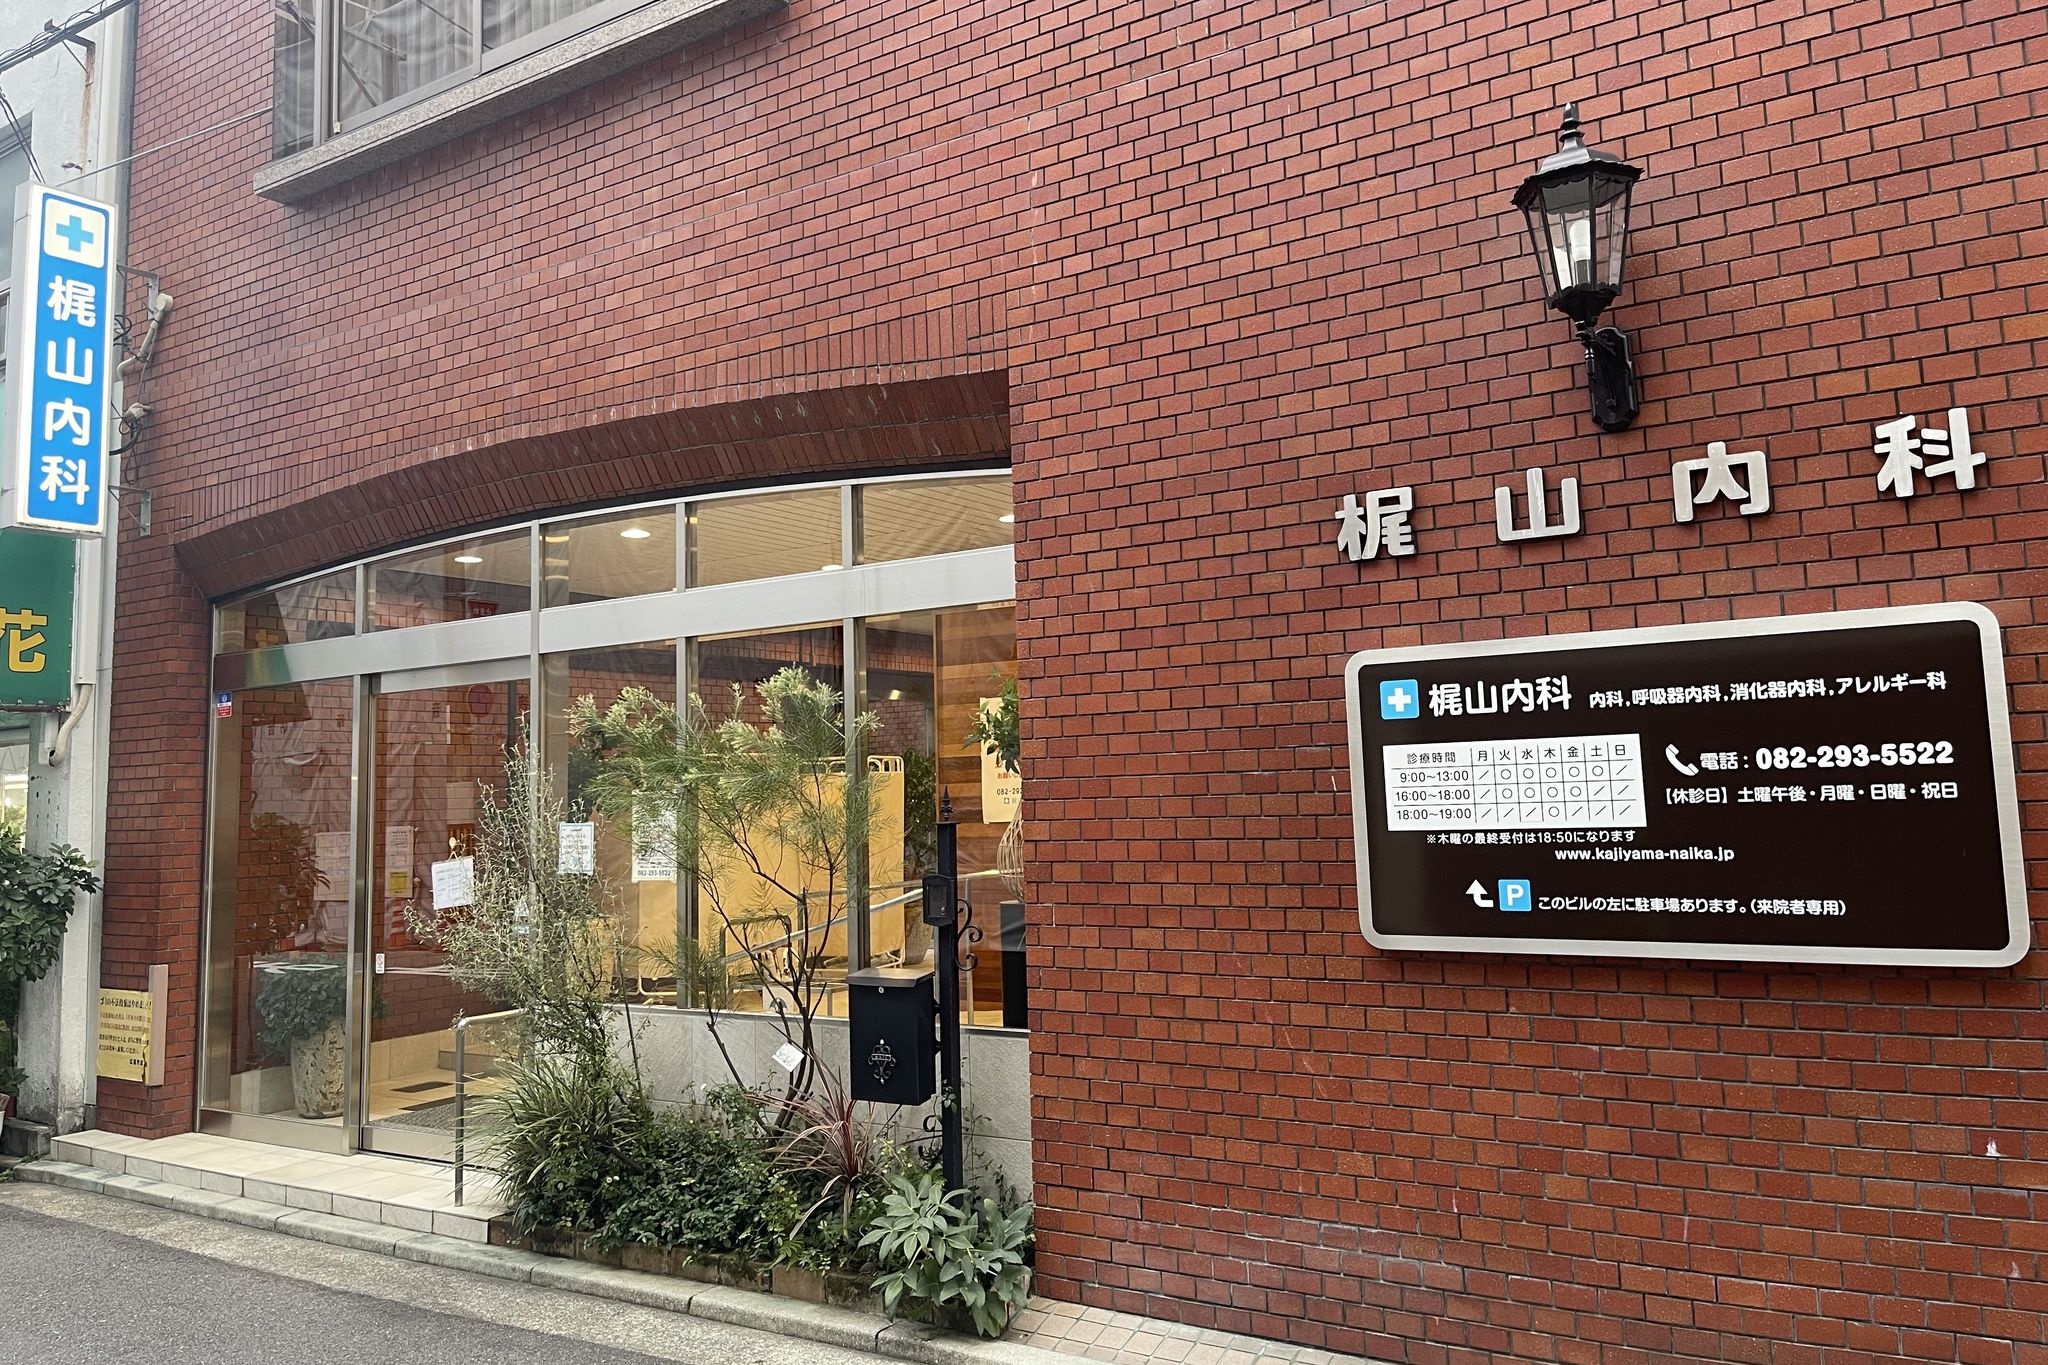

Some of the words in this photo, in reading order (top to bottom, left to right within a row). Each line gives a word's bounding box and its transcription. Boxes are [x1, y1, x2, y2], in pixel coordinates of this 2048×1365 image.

[40, 274, 97, 505] 梶山内科
[1335, 406, 1987, 563] 梶山内科
[1428, 674, 1572, 718] 梶山内科
[1406, 751, 1456, 765] 診療時間
[1476, 750, 1489, 762] 月
[1498, 749, 1511, 761] 火
[1521, 749, 1534, 760] 水
[1544, 747, 1557, 759] 木
[1567, 746, 1580, 758] 金
[1590, 745, 1604, 757] 土
[1615, 744, 1626, 756] 日
[1755, 740, 1955, 770] 082-293-5522
[1555, 847, 1735, 861] www.kajiyama-naika.jp
[1506, 884, 1524, 906] P
